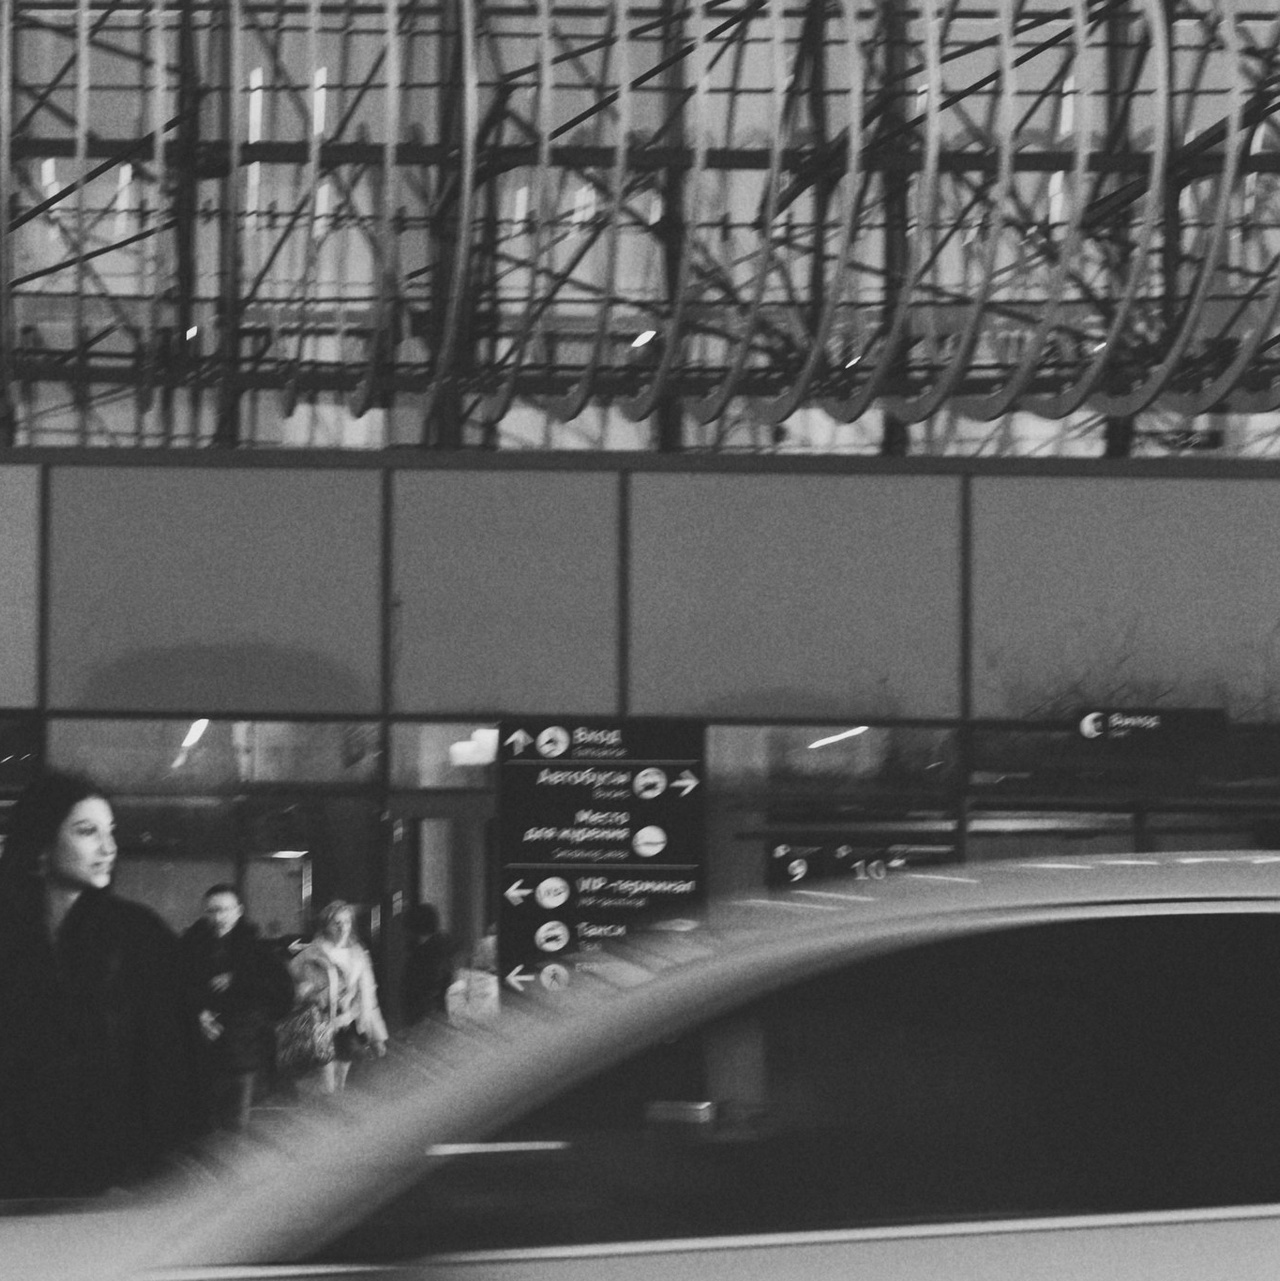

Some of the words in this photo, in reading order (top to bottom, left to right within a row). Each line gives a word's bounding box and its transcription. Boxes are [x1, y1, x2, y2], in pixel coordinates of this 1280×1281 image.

[573, 727, 621, 745] Вход
[536, 768, 631, 789] Автобусы
[574, 809, 630, 825] Место
[788, 858, 808, 882] 9
[851, 859, 887, 880] 10
[577, 876, 696, 898] VIP-терминал
[577, 922, 626, 937] Такси
